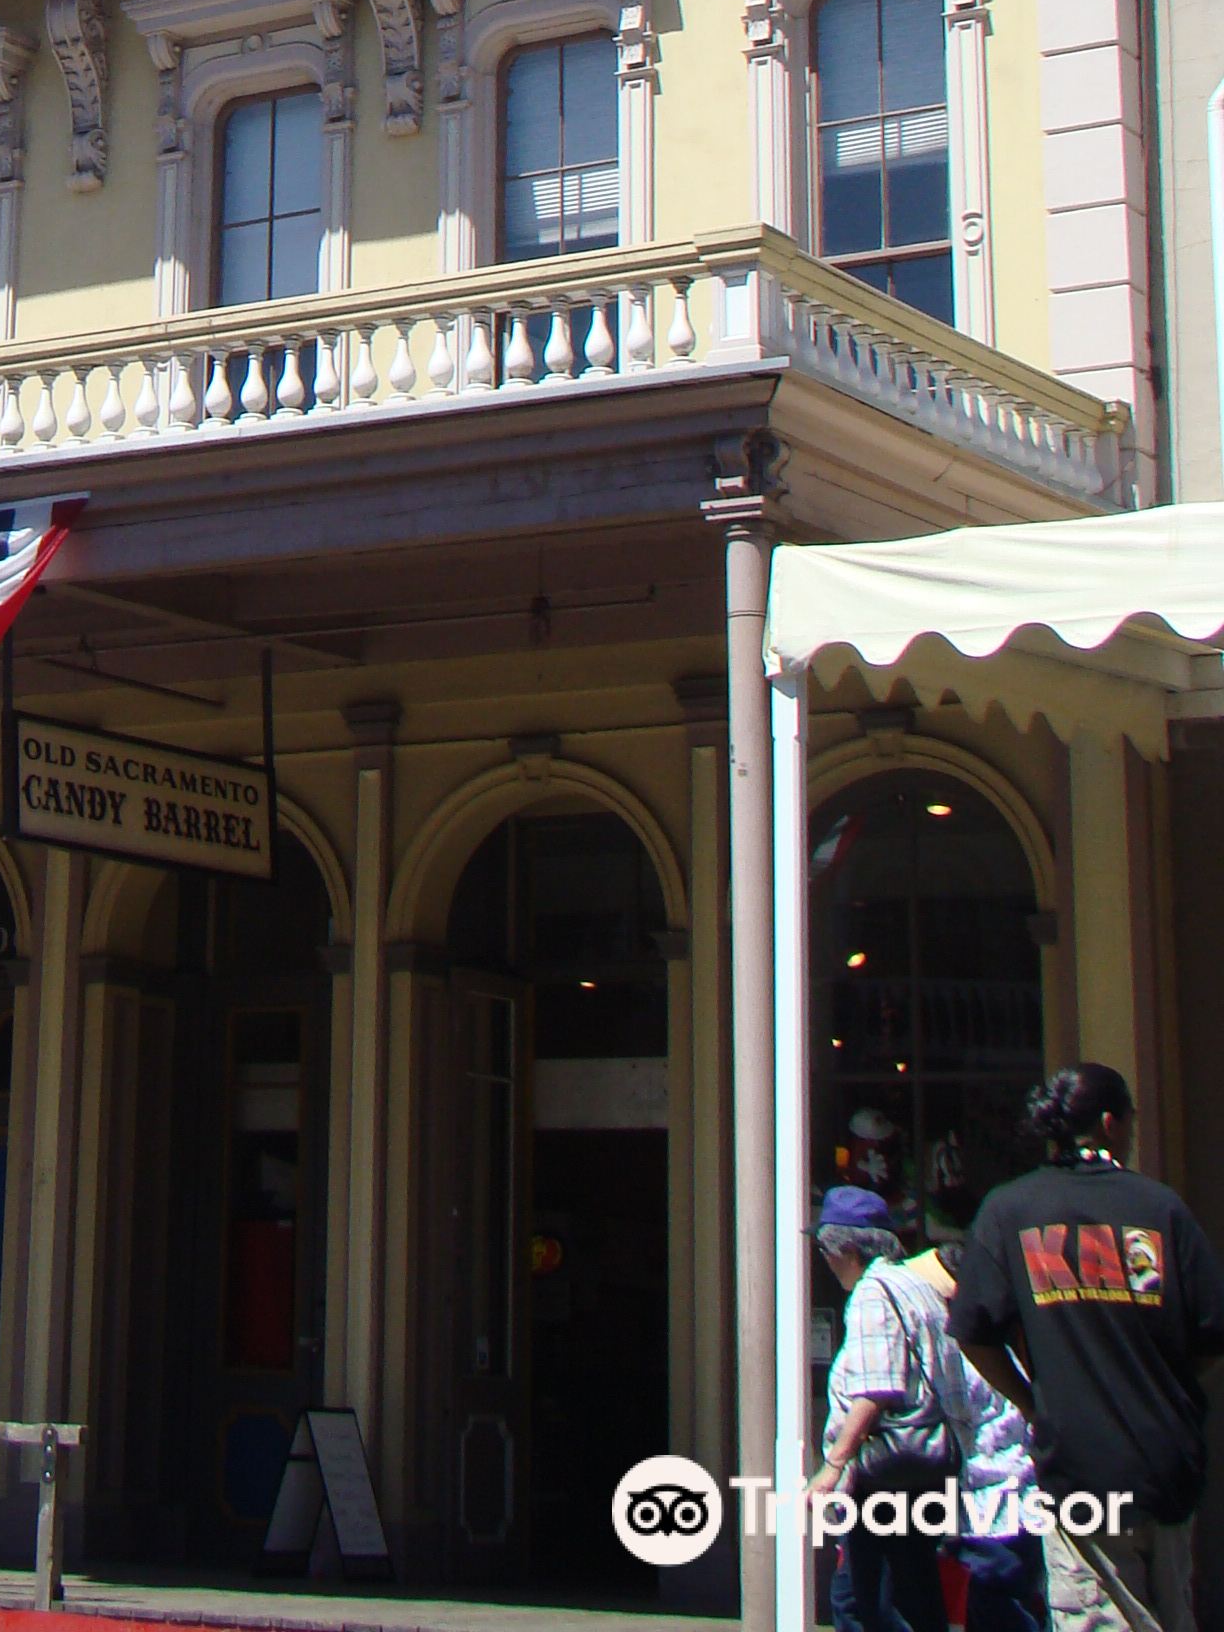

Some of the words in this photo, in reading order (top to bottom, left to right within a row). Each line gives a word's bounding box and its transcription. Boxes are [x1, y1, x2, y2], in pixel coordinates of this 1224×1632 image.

[23, 738, 76, 767] OLD
[85, 751, 259, 806] SACRAMENTO
[23, 774, 126, 826] CANDY
[144, 796, 261, 851] BARREL
